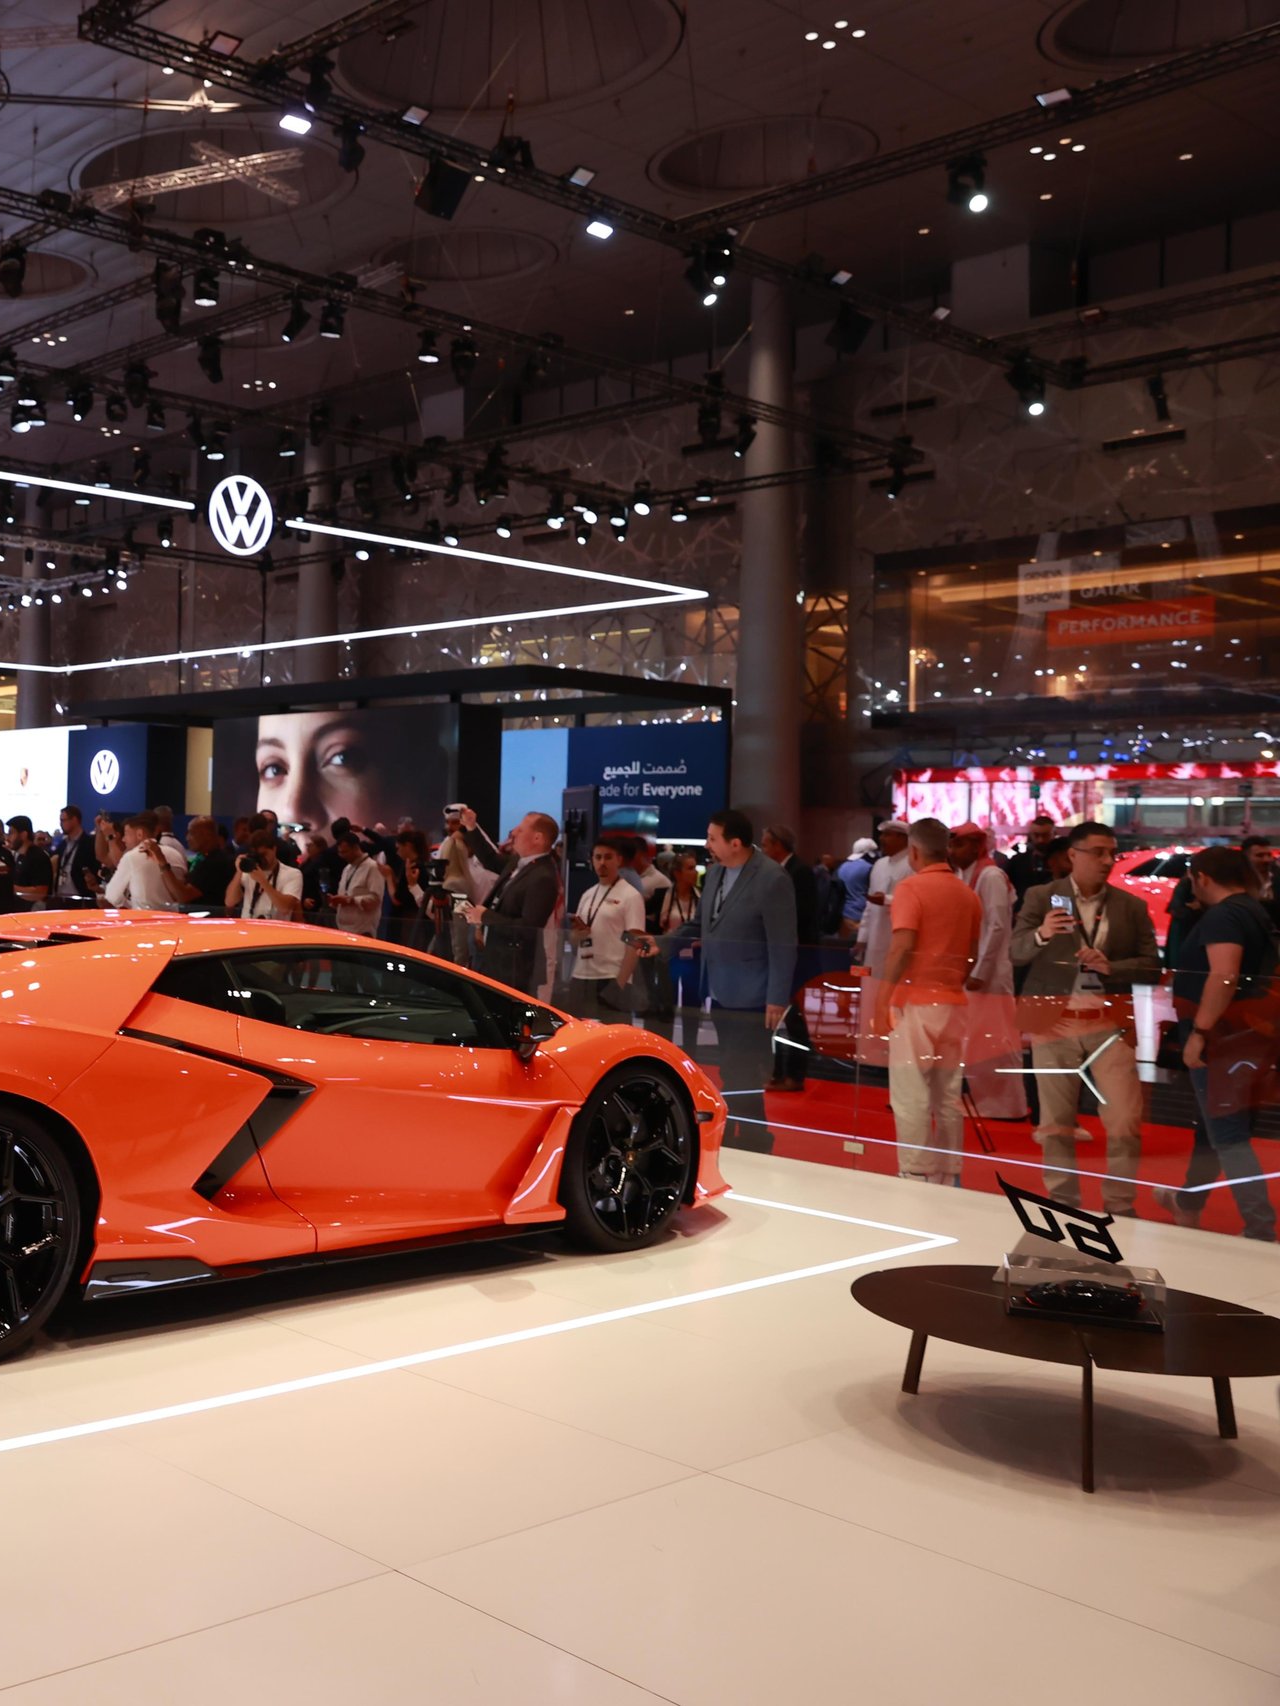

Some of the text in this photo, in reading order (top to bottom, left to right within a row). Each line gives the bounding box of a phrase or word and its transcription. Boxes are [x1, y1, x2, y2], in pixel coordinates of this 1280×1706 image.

[1057, 608, 1201, 636] PERFORMANCE
[598, 782, 702, 799] ade for Everyone
